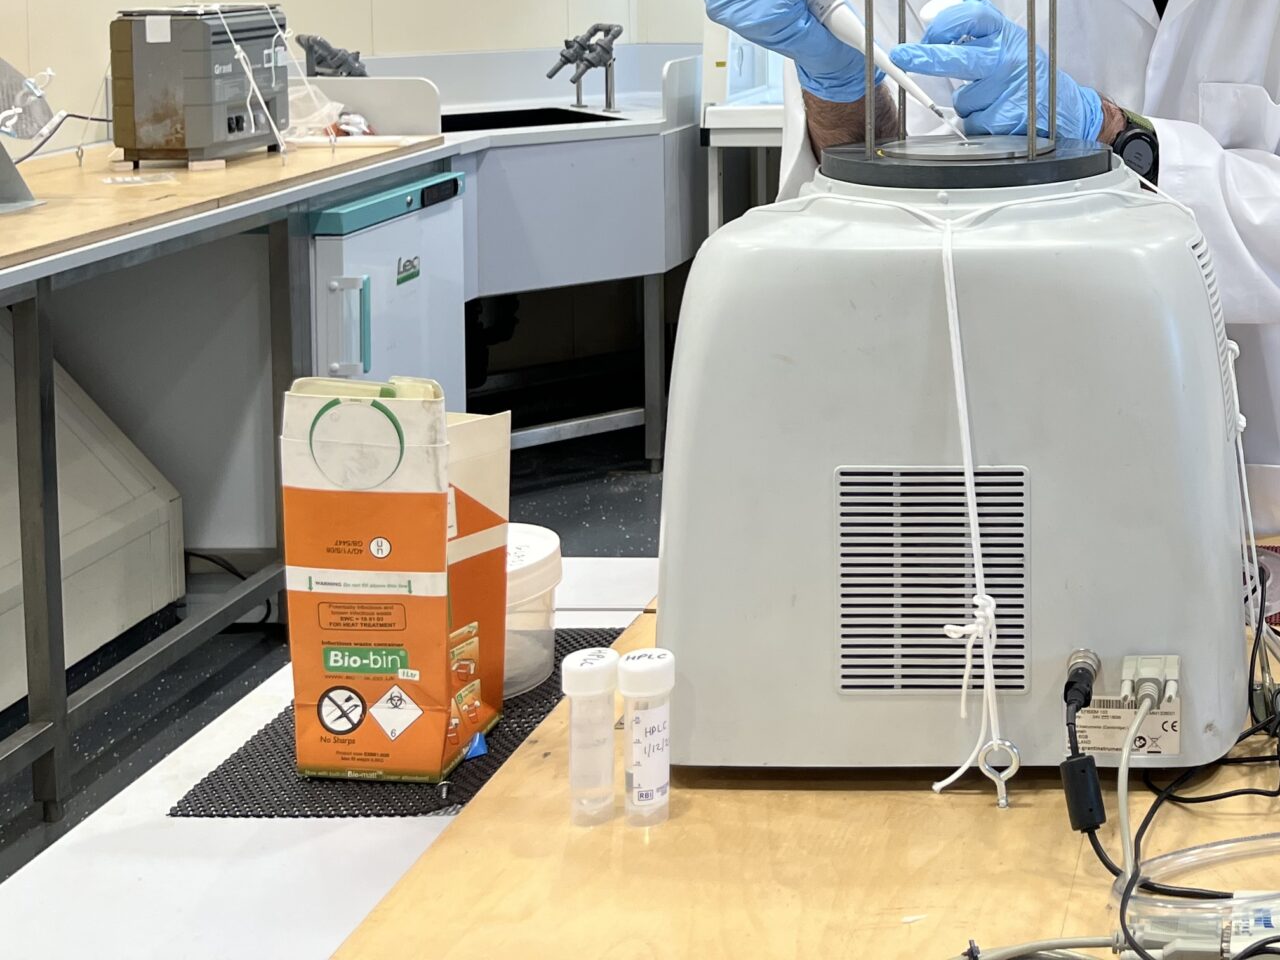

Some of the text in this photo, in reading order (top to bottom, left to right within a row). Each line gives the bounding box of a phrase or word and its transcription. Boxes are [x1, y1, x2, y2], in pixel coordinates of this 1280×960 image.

[625, 653, 668, 662] HPLC
[391, 729, 397, 738] 6
[644, 721, 668, 738] HPLC
[320, 736, 356, 745] No Sharps
